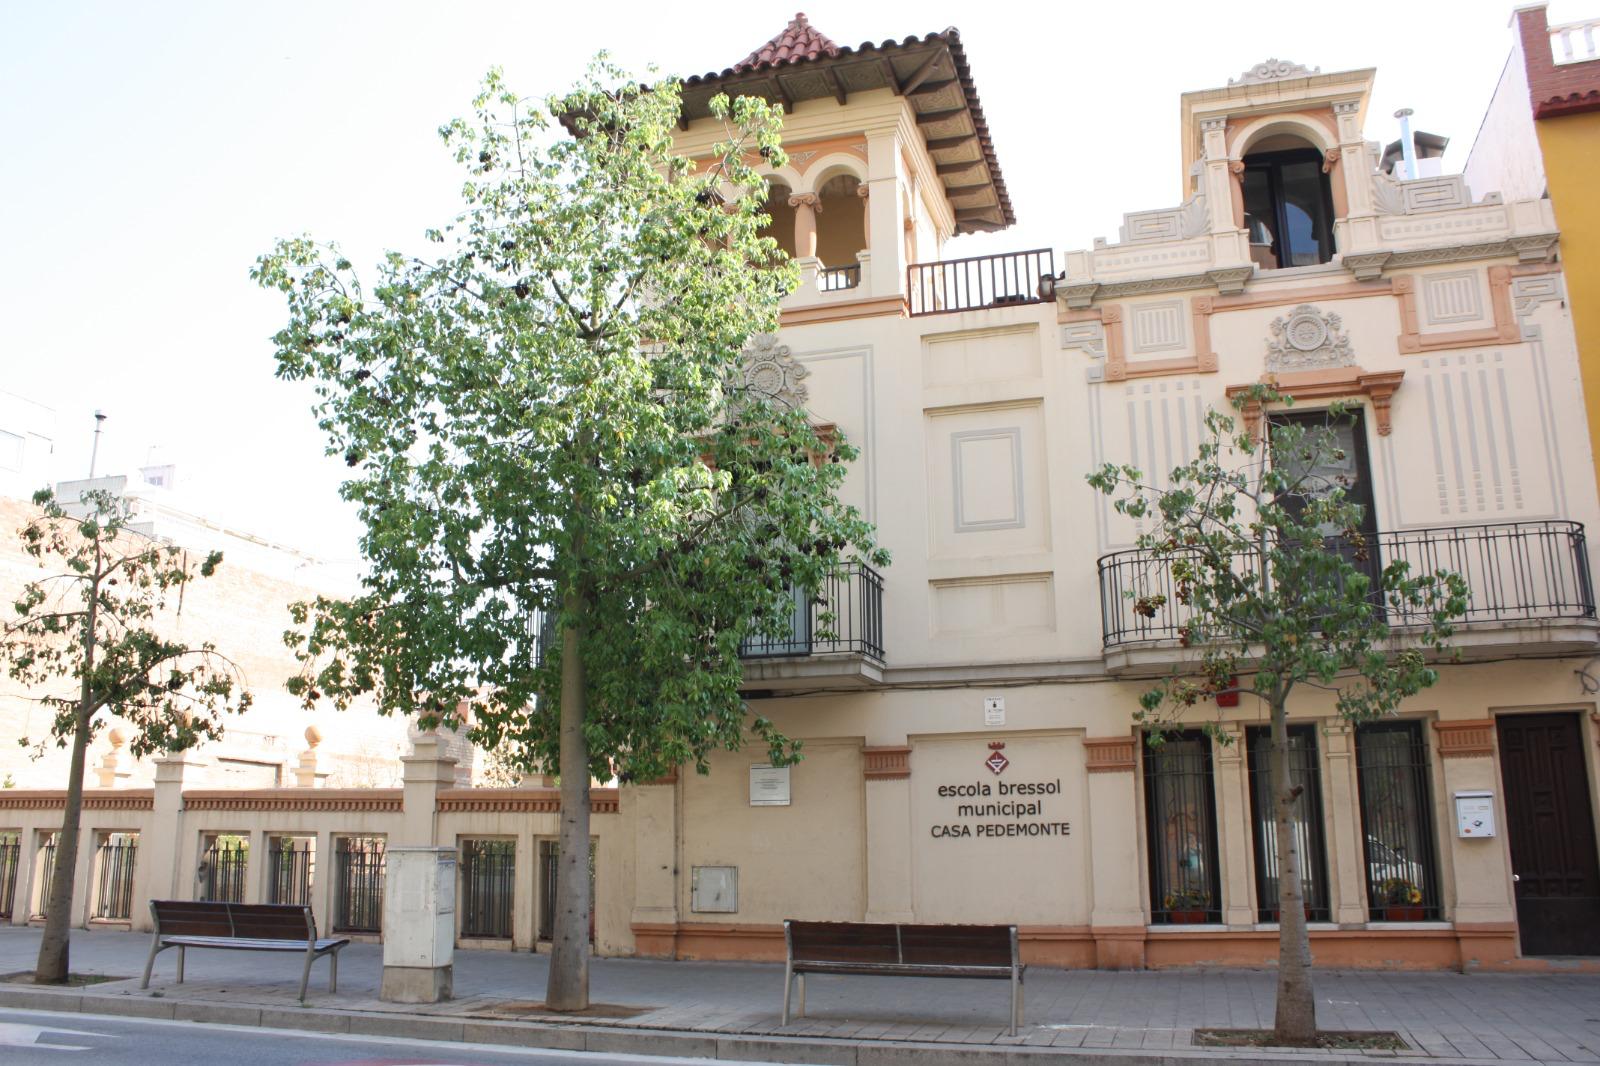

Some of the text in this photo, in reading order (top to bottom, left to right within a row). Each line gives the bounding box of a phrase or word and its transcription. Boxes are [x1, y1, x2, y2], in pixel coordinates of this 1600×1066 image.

[938, 779, 1061, 797] escola bressol
[958, 800, 1042, 819] municipal
[931, 822, 1070, 838] CASA PEDEMONTE
